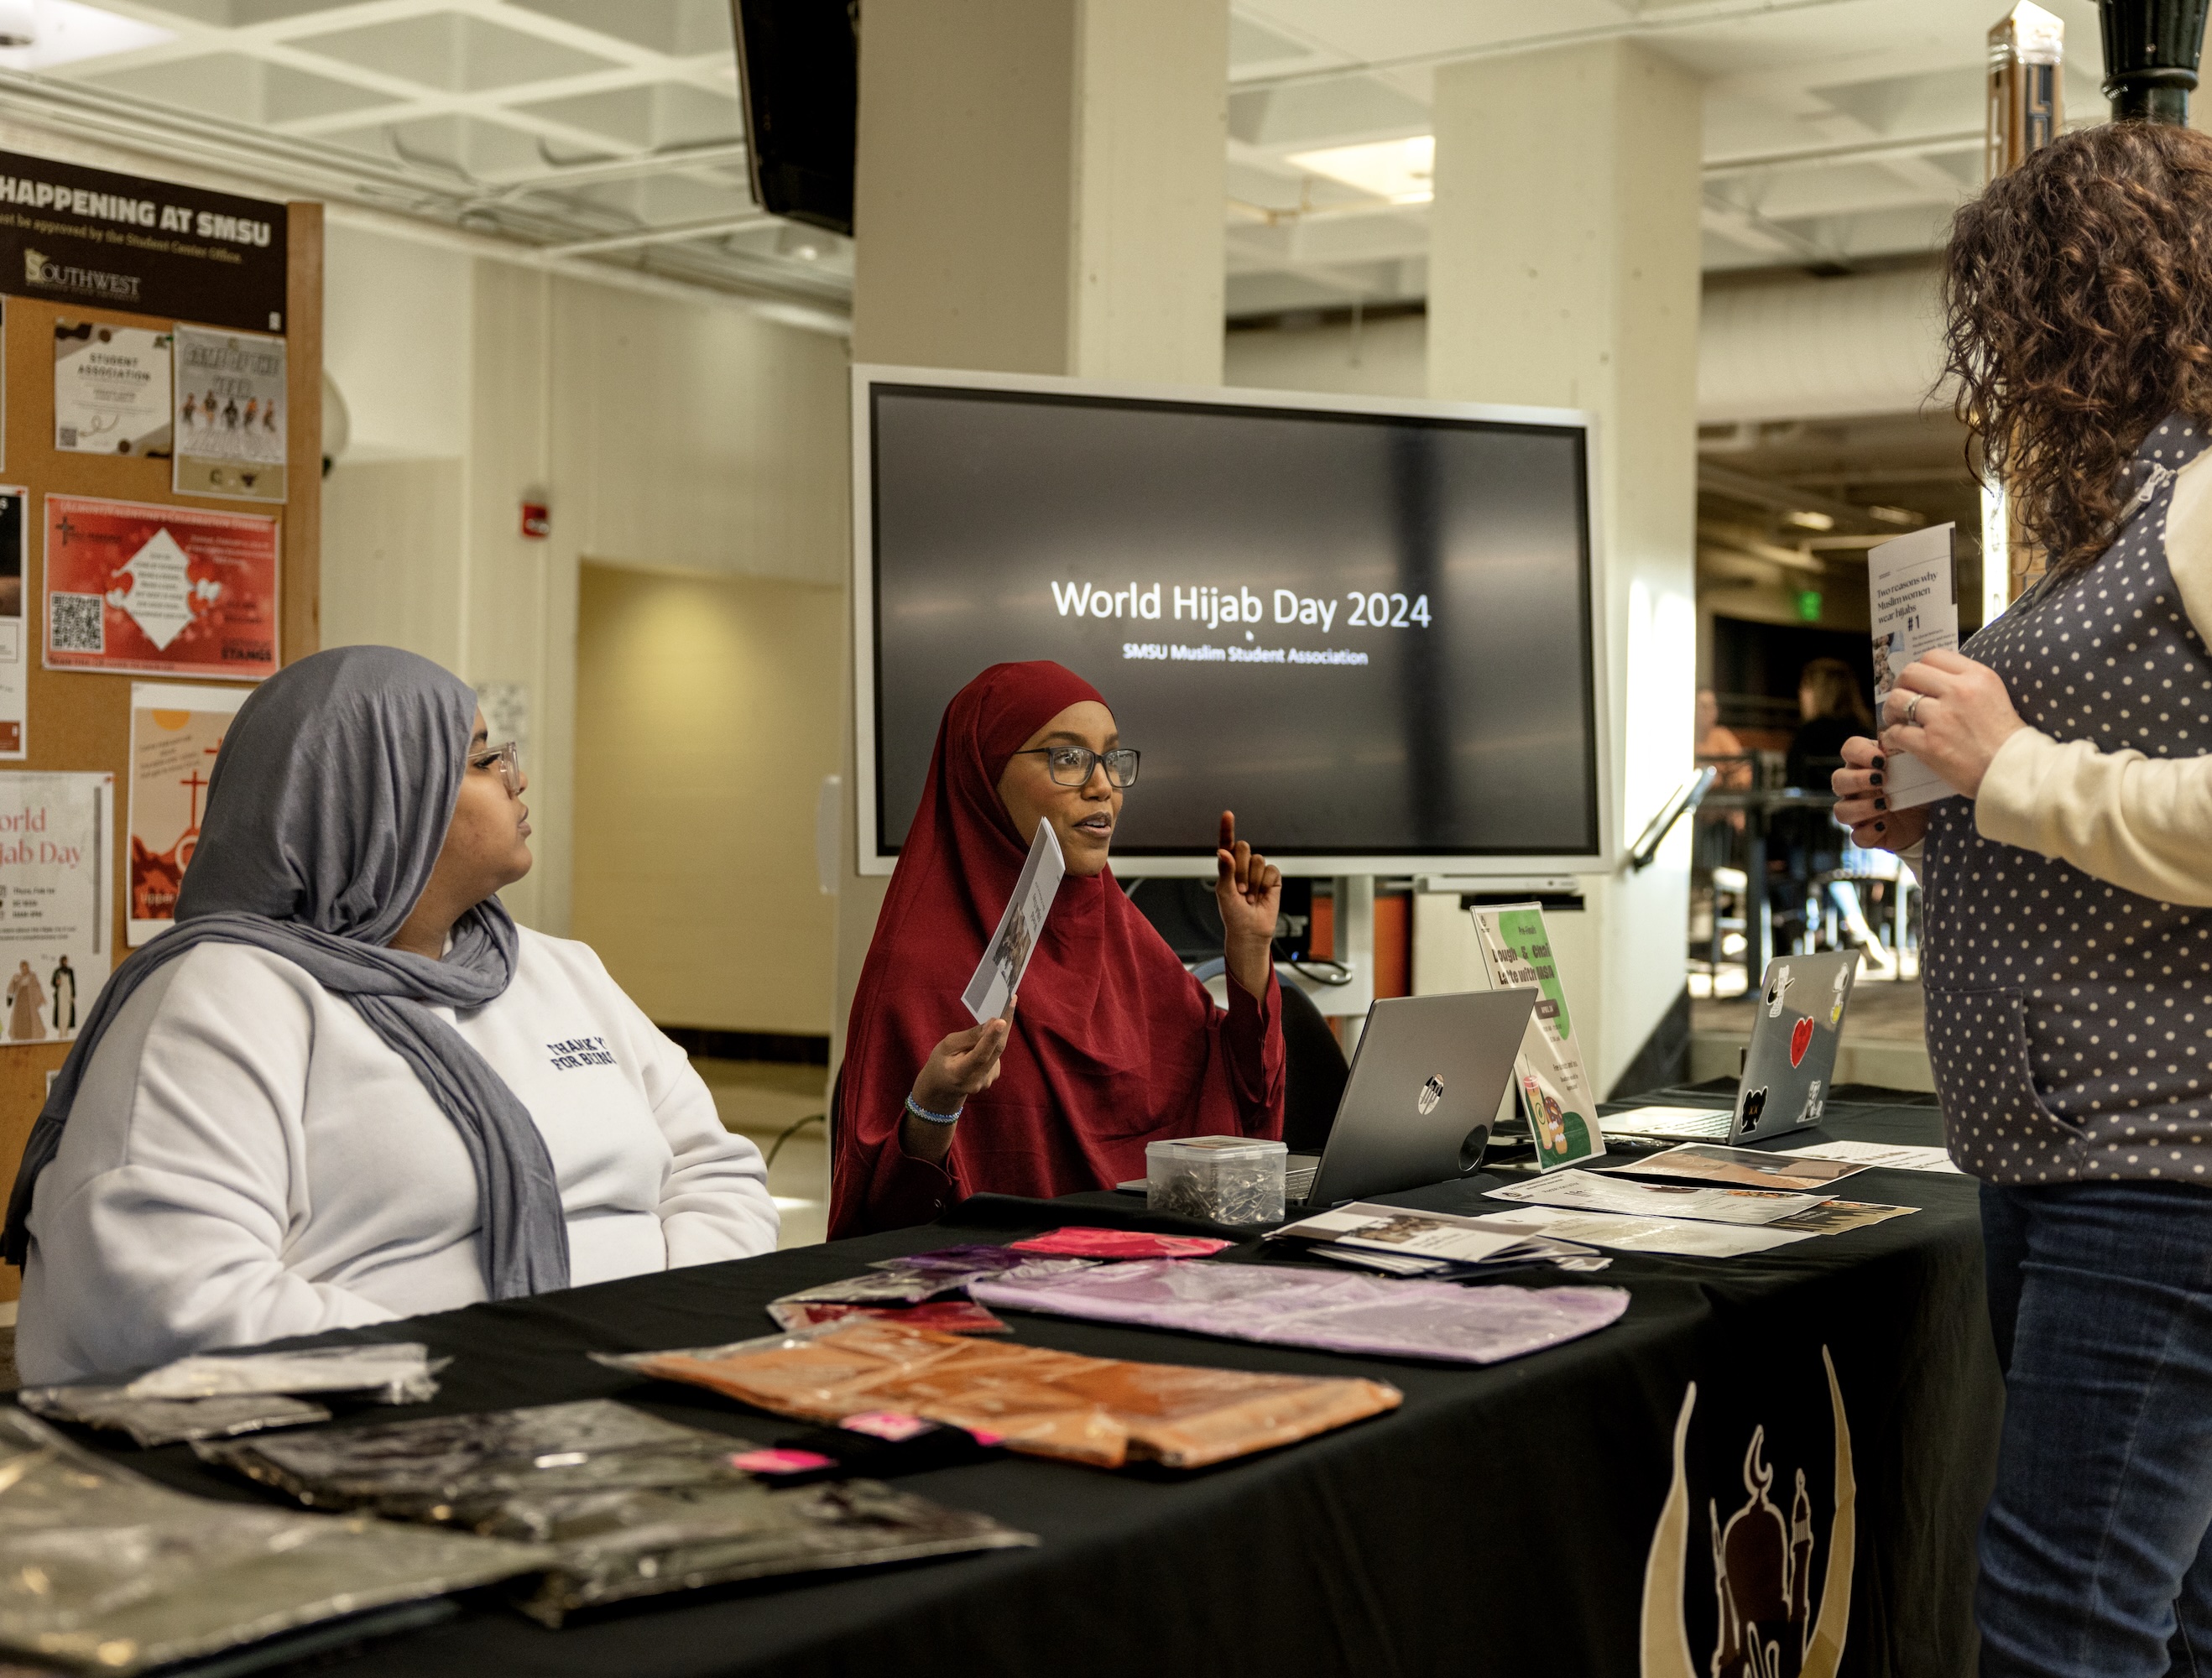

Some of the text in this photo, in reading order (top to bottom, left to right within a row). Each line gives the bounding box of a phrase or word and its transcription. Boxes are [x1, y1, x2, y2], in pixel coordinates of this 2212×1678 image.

[0, 175, 271, 248] HAPPENING AT SMSU
[90, 352, 138, 367] STUDENT
[77, 364, 151, 381] ASSOCIATION
[1878, 571, 1938, 598] Two reasons why
[1051, 581, 1432, 633] World Hijab Day 2024
[1878, 587, 1931, 611] Muslim women
[1878, 604, 1917, 623] wear hijabs
[1123, 643, 1369, 665] SMSU Muslim Student Association
[0, 806, 46, 833] orld
[40, 840, 81, 869] Day
[1521, 946, 1529, 959] &
[1532, 943, 1552, 958] Chai
[1518, 967, 1537, 982] with
[1536, 965, 1555, 980] MSA
[546, 1039, 598, 1055] THANK
[550, 1055, 583, 1071] FOR
